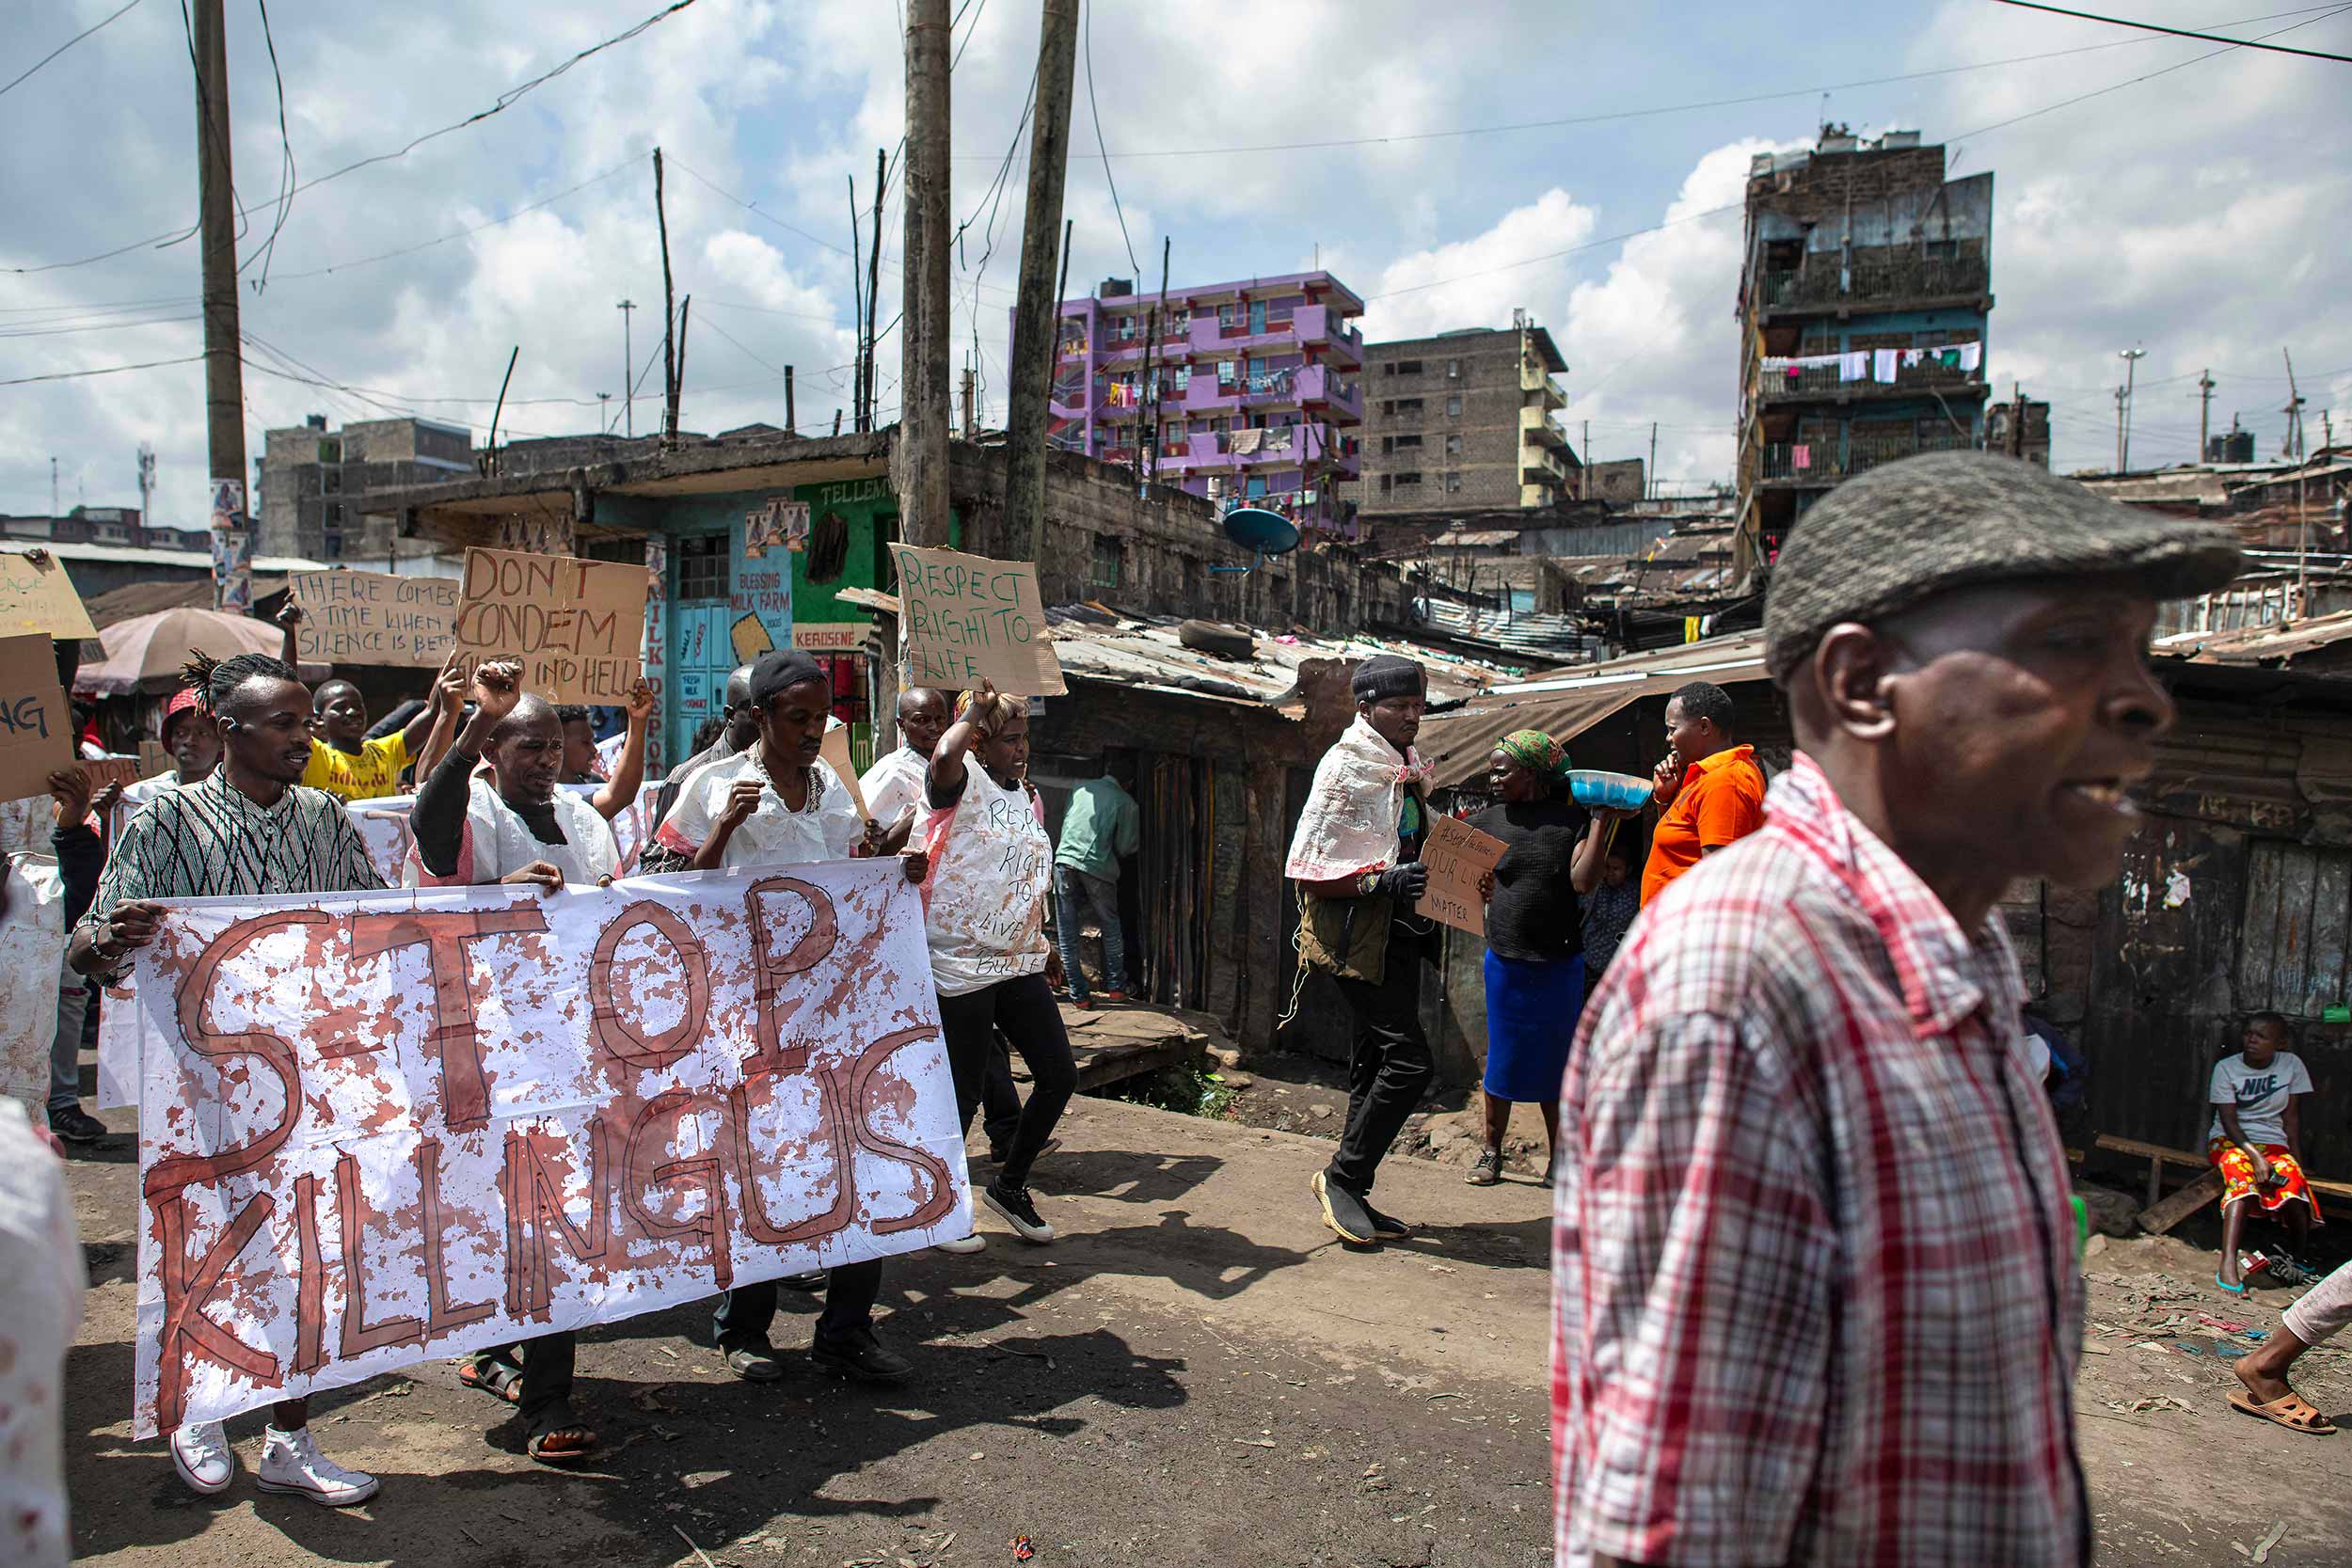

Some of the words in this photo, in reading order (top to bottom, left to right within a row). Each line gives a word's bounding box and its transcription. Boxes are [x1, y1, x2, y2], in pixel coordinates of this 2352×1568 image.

[291, 573, 383, 603] THERE
[396, 580, 459, 606] COMES
[739, 572, 781, 590] BLESSING
[899, 550, 1032, 607] RESPECT
[731, 592, 754, 611] MILK
[759, 591, 790, 612] FARM
[301, 607, 315, 626] A
[321, 605, 374, 628] TIME
[386, 609, 441, 632] WHEN
[457, 601, 617, 655] CONDEM
[911, 598, 993, 647] RIGHT
[993, 607, 1031, 646] TO
[299, 627, 384, 655] SILENCE
[392, 634, 405, 649] IS
[796, 630, 855, 647] KEROSENE
[534, 657, 578, 687] INTO
[581, 657, 632, 697] HELL
[921, 642, 980, 680] LIFE
[999, 845, 1047, 878] RIGH
[1427, 847, 1457, 883] OUR
[1460, 866, 1480, 889] LIV
[1009, 879, 1032, 902] TO
[1430, 894, 1468, 923] MATTER
[145, 877, 839, 1198] STOP
[2240, 1074, 2278, 1096] NIKE
